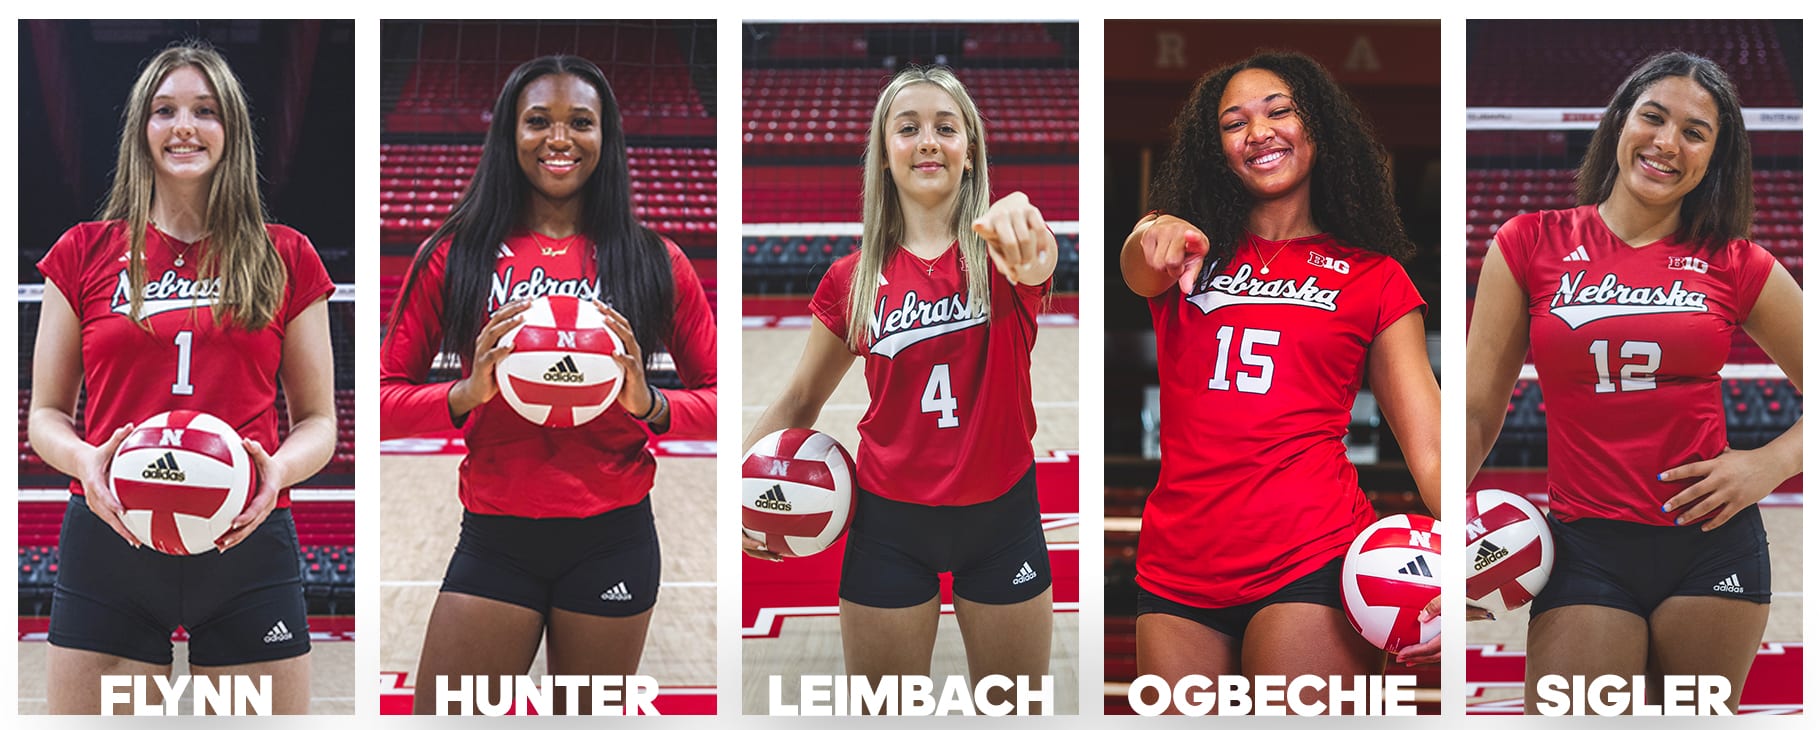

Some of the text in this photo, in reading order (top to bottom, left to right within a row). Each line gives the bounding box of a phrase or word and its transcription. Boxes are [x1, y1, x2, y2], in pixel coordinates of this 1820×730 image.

[1550, 270, 1708, 308] Nebraska
[557, 330, 577, 348] N
[172, 330, 194, 395] 1
[1208, 325, 1281, 394] 15
[1588, 339, 1662, 394] 12
[543, 371, 584, 383] adidas
[920, 363, 960, 429] 4
[159, 429, 185, 447] N
[141, 466, 186, 482] adidas
[767, 460, 790, 477] N
[754, 498, 793, 512] adidas
[1466, 517, 1489, 541] N
[1409, 529, 1433, 549] N
[1474, 547, 1509, 571] adidas
[1012, 571, 1037, 586] adidas
[1712, 583, 1745, 594] adidas
